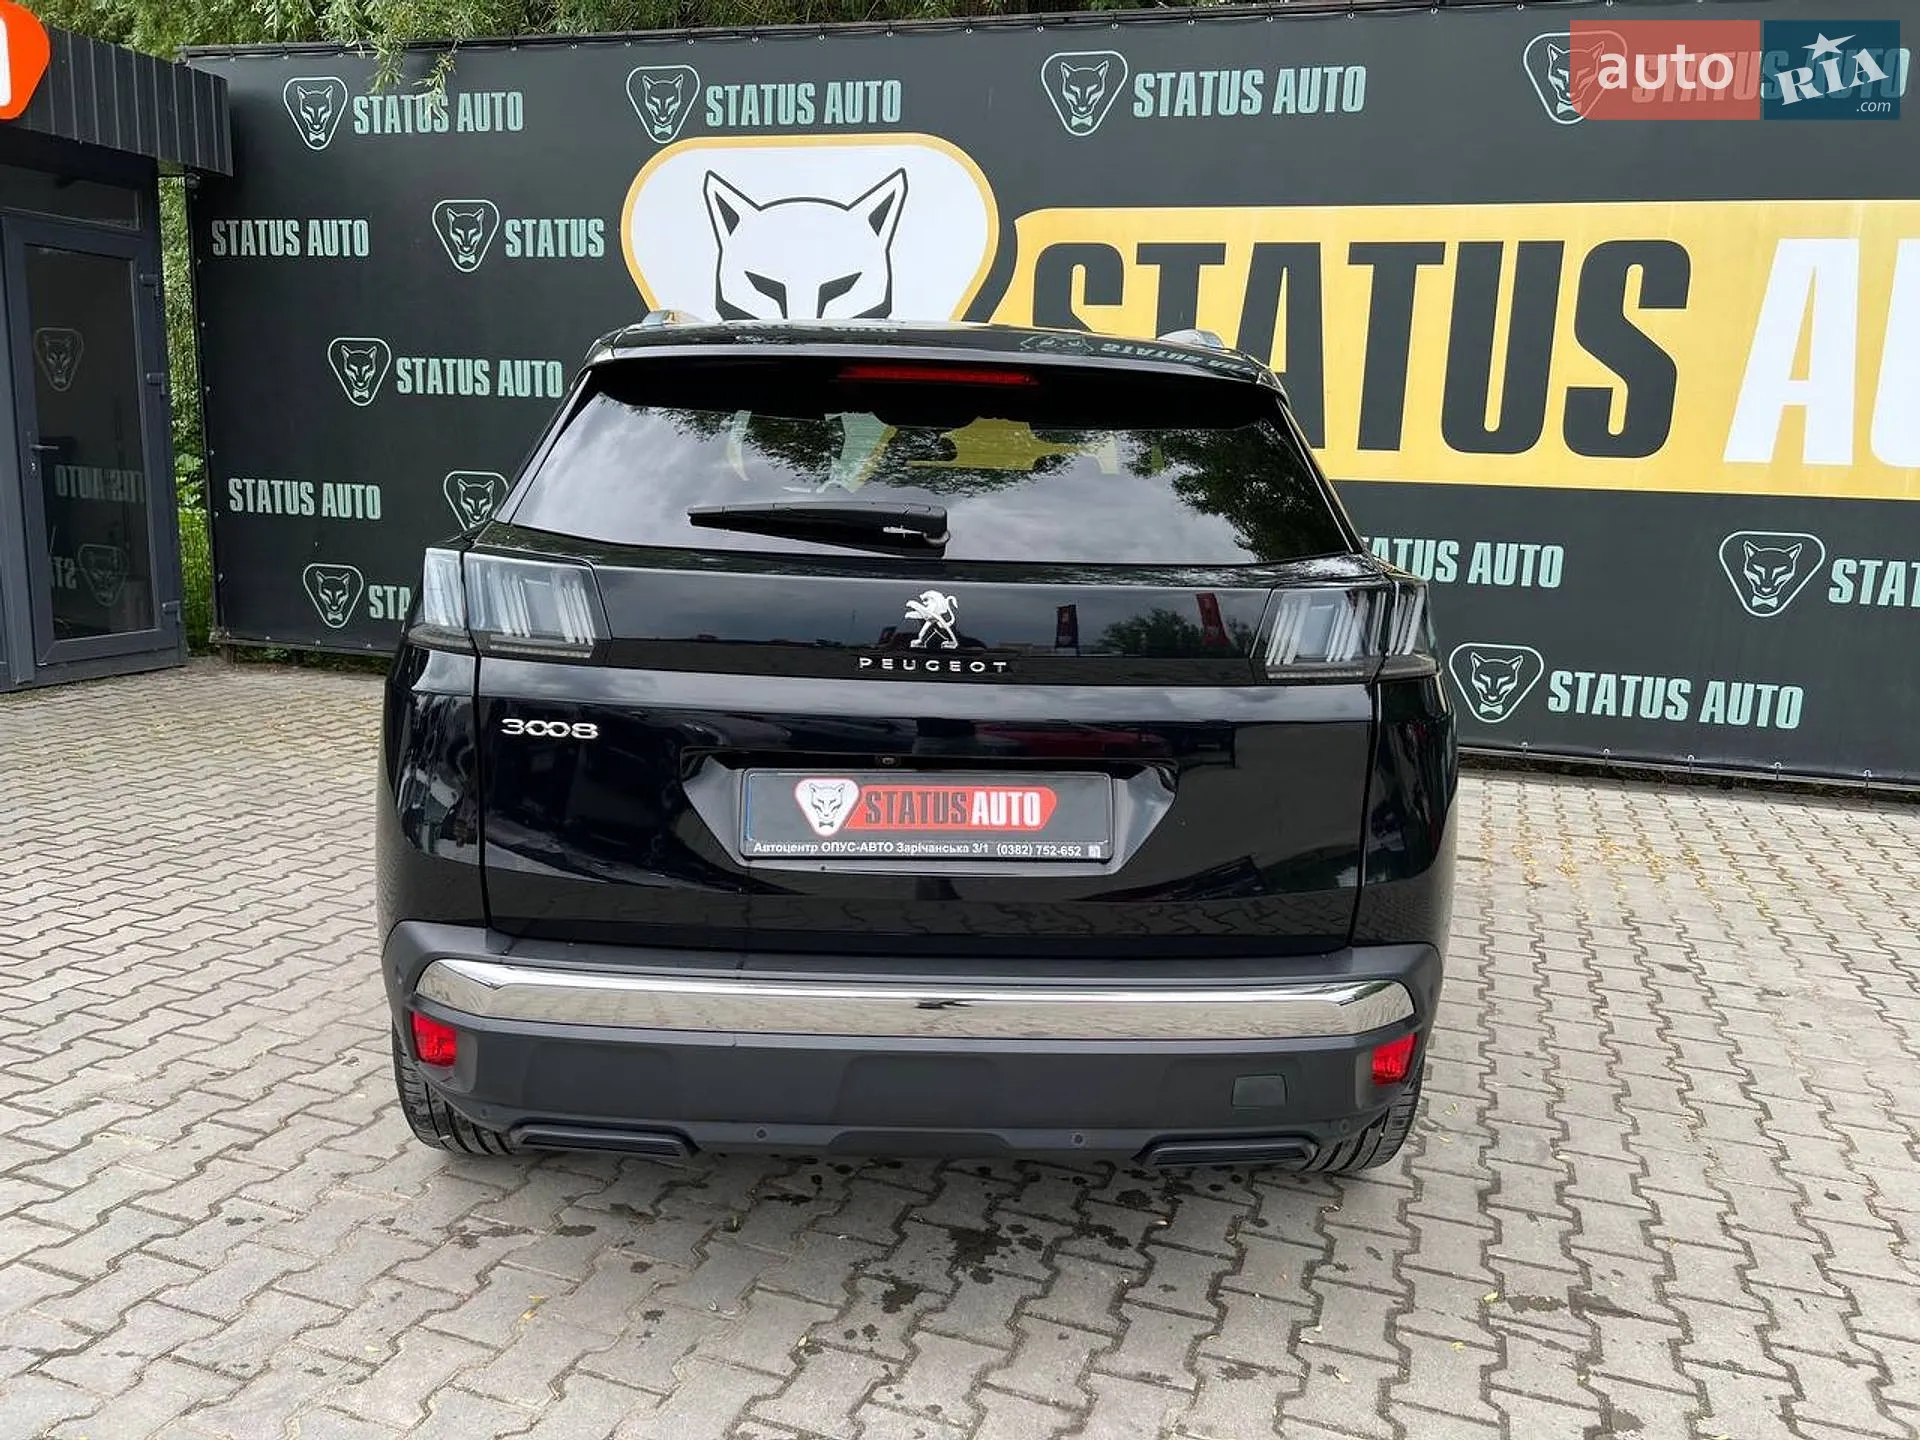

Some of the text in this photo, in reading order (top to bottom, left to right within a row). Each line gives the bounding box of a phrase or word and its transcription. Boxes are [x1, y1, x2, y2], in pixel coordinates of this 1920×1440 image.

[353, 91, 524, 134] STATUS AUTO
[705, 79, 902, 127] STATUS AUTO
[1133, 66, 1367, 118] STATUS AUTO
[211, 219, 371, 257] STATUS AUTO
[504, 219, 605, 258] STATUS
[396, 357, 563, 398] STATUS AUTO
[229, 478, 381, 519] STATUS AUTO
[1361, 536, 1565, 588] ATUS AUTO
[858, 656, 1007, 673] PEUGEOT
[1547, 670, 1804, 729] STATUS AUTO
[501, 718, 599, 739] 3008
[865, 791, 1041, 826] STATUS AUTO
[753, 842, 818, 854] Автоцентр
[820, 841, 894, 853] ОПУС-АВТО
[972, 843, 989, 853] 3/1
[996, 844, 1033, 856] (0382)
[1035, 845, 1082, 857] 752-652
